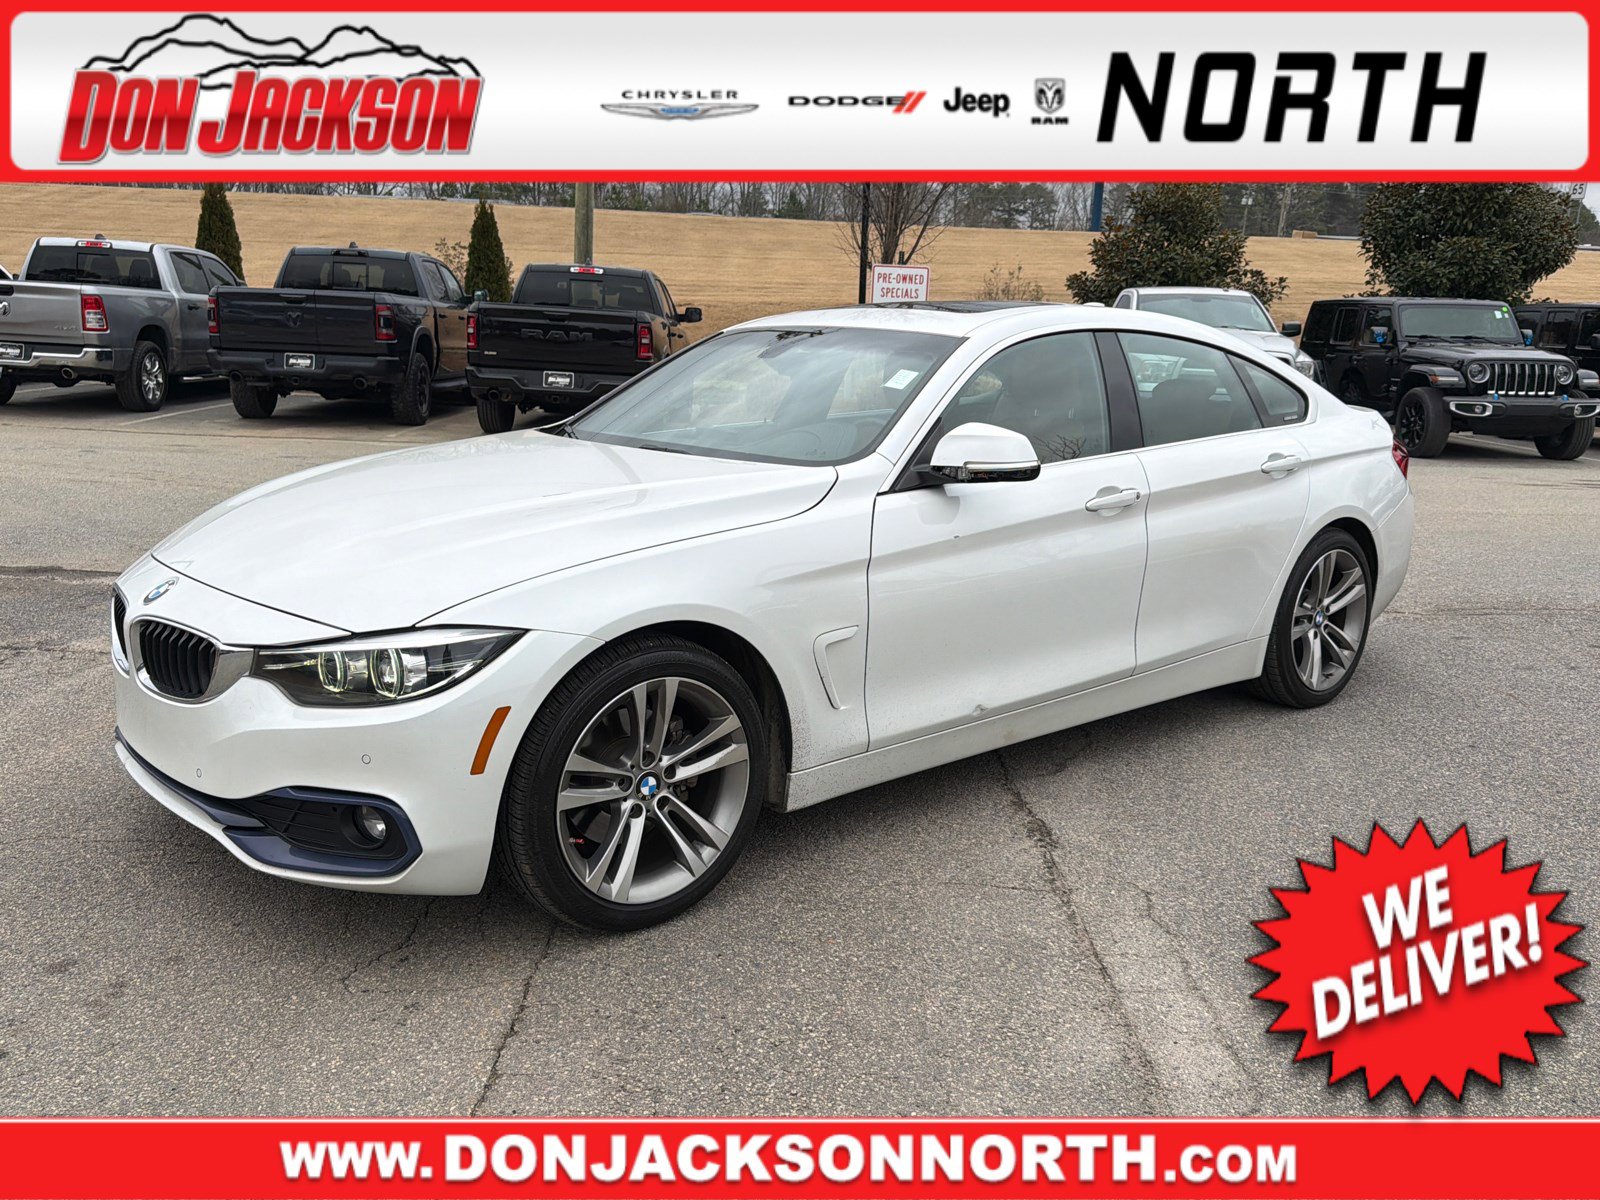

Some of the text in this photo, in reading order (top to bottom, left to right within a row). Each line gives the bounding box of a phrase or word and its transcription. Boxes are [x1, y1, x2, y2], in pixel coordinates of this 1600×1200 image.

[1572, 183, 1585, 195] 65
[877, 272, 925, 285] PRE-OWNED
[880, 287, 920, 299] SPECIALS
[520, 328, 593, 341] RAM
